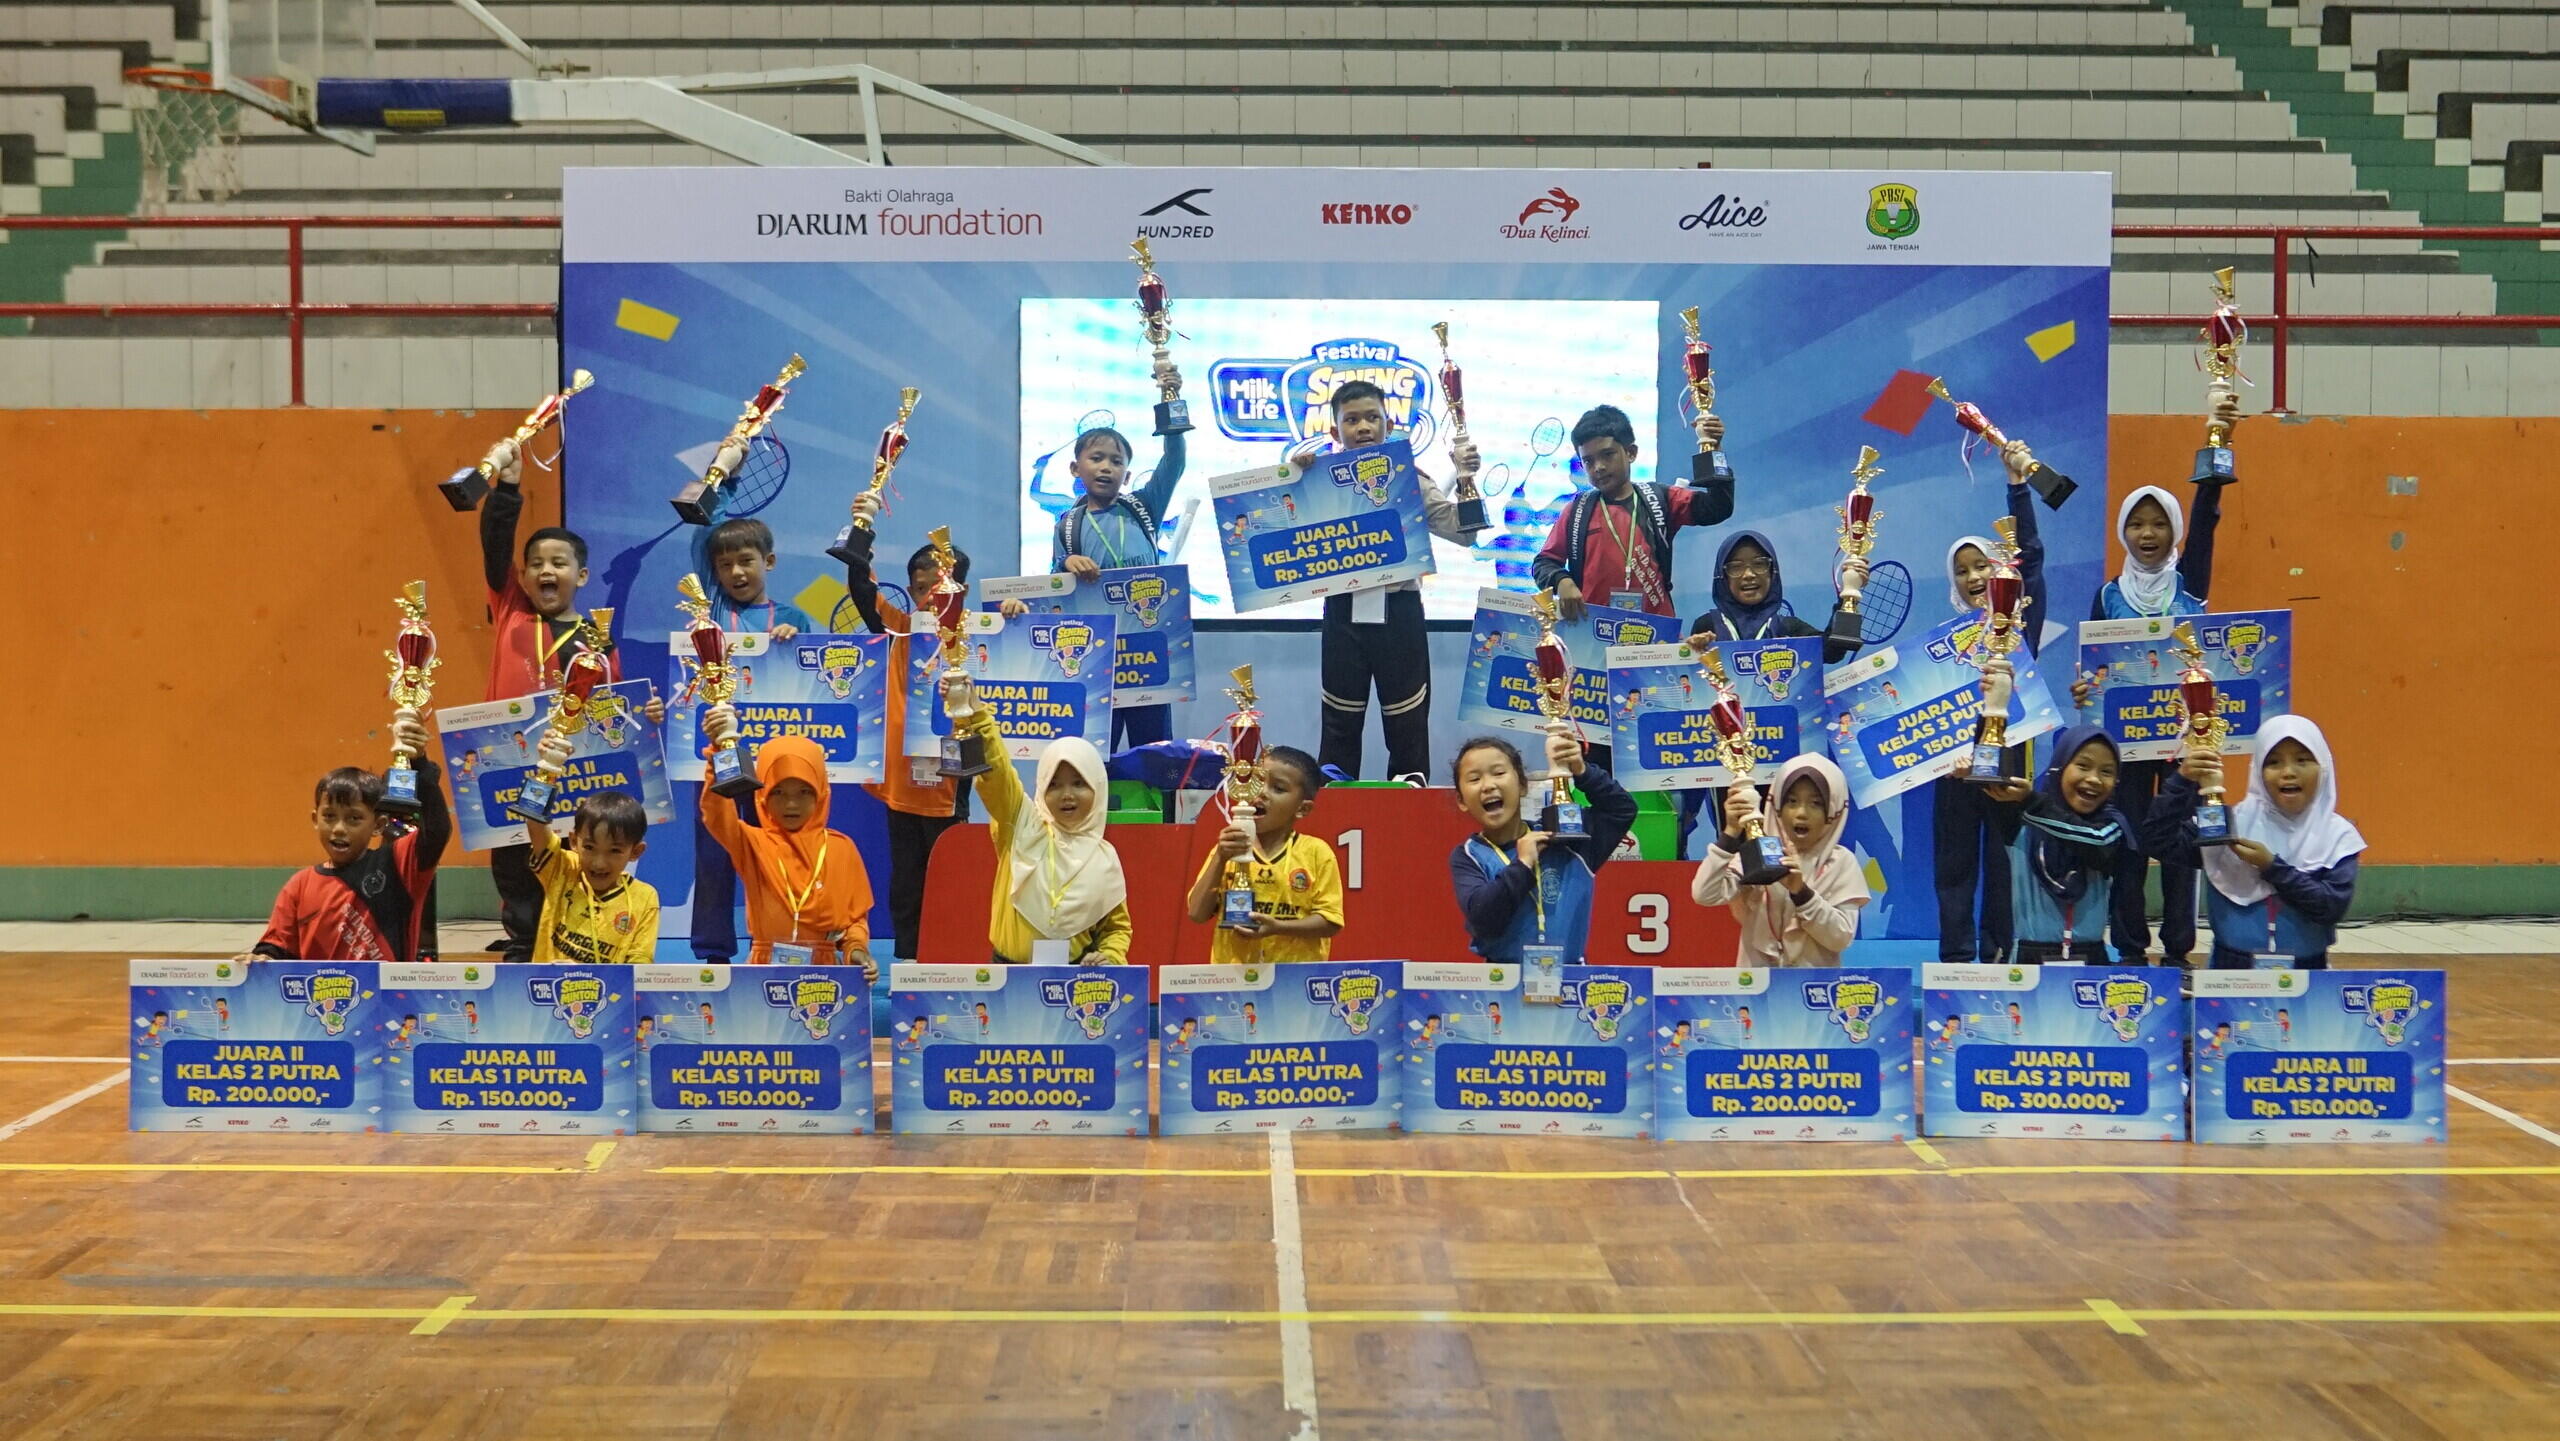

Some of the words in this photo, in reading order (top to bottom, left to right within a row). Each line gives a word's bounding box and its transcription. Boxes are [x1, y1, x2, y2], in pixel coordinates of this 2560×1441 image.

[845, 190, 882, 202] Bakti
[887, 190, 954, 205] Olahraga
[1880, 188, 1905, 202] PBSI
[757, 214, 868, 238] DJARUM
[878, 208, 1042, 236] foundation
[1137, 226, 1214, 238] HUNDRED
[1500, 225, 1536, 239] Dua
[1540, 225, 1588, 243] Kelinci
[1316, 342, 1394, 363] Festival
[1230, 378, 1277, 399] Milk
[1238, 401, 1278, 419] Life
[1357, 457, 1387, 472] SENENG
[1358, 466, 1388, 481] MINTON
[1292, 522, 1349, 545] JUARA
[1353, 521, 1358, 533] I
[1263, 546, 1318, 566] KELAS
[1322, 542, 1332, 554] 3
[1336, 530, 1393, 551] PUTRA
[1275, 568, 1302, 583] Rp.
[1307, 551, 1387, 576] 300.000,-
[1130, 579, 1162, 590] SENENG
[1132, 587, 1162, 599] MINTON
[1056, 627, 1089, 638] SENENG
[1055, 636, 1088, 647] MINTON
[1591, 674, 1606, 688] III
[1032, 687, 1048, 700] III
[1002, 703, 1012, 715] 2
[1016, 704, 1074, 717] PUTRA
[1509, 696, 1534, 711] Rp.
[1897, 699, 1955, 731] JUARA
[1955, 690, 1974, 706] III
[741, 708, 802, 721] JUARA
[807, 708, 812, 721] I
[2120, 705, 2176, 720] KELAS
[770, 724, 781, 737] 2
[785, 724, 846, 738] PUTRA
[1655, 730, 1712, 745] KELAS
[1878, 725, 1935, 755] KELAS
[1938, 718, 1950, 731] 3
[2124, 724, 2151, 739] Rp.
[1661, 751, 1689, 765] Rp.
[1893, 752, 1922, 769] Rp.
[584, 761, 595, 774] II
[568, 773, 628, 793] PUTRA
[1338, 829, 1362, 888] 1
[1626, 893, 1670, 953] 3
[317, 968, 346, 976] Festival
[928, 975, 967, 983] foundation
[1077, 972, 1106, 980] Festival
[313, 977, 353, 989] SENENG
[560, 980, 599, 992] SENENG
[1046, 984, 1063, 993] Milk
[1073, 981, 1113, 993] SENENG
[313, 987, 351, 1000] MINTON
[1048, 991, 1064, 1000] Life
[1072, 991, 1112, 1004] MINTON
[213, 1046, 284, 1062] JUARA
[290, 1046, 304, 1060] II
[460, 1050, 530, 1066] JUARA
[536, 1050, 556, 1066] III
[697, 1050, 768, 1066] JUARA
[774, 1052, 792, 1066] III
[974, 1050, 1046, 1066] JUARA
[1052, 1050, 1064, 1064] II
[1245, 1048, 1314, 1064] JUARA
[1320, 1048, 1326, 1060] I
[1489, 1050, 1560, 1066] JUARA
[1566, 1052, 1572, 1066] I
[1738, 1054, 1808, 1070] JUARA
[1816, 1054, 1828, 1068] II
[2010, 1052, 2080, 1066] JUARA
[2088, 1054, 2094, 1066] I
[176, 1064, 246, 1080] KELAS
[252, 1064, 264, 1080] 2
[268, 1064, 340, 1080] PUTRA
[1208, 1068, 1276, 1084] KELAS
[1280, 1066, 1288, 1080] 1
[1294, 1064, 1362, 1080] PUTRA
[2272, 1058, 2342, 1074] JUARA
[2348, 1058, 2366, 1072] III
[430, 1068, 498, 1084] KELAS
[504, 1068, 510, 1082] 1
[516, 1068, 586, 1084] PUTRA
[672, 1068, 740, 1084] KELAS
[744, 1068, 754, 1084] 1
[758, 1068, 820, 1084] PUTRI
[944, 1068, 1014, 1084] KELAS
[1018, 1068, 1026, 1082] 1
[1032, 1068, 1094, 1084] PUTRI
[1456, 1068, 1524, 1084] KELAS
[1530, 1070, 1538, 1084] 1
[1544, 1070, 1606, 1086] PUTRI
[1706, 1074, 1774, 1090] KELAS
[1782, 1074, 1792, 1088] 2
[1798, 1072, 1862, 1088] PUTRI
[1974, 1070, 2044, 1086] KELAS
[2050, 1070, 2062, 1086] 2
[2068, 1070, 2130, 1086] PUTRI
[2244, 1076, 2310, 1092] KELAS
[2316, 1078, 2328, 1092] 2
[2334, 1076, 2394, 1092] PUTRI
[188, 1086, 220, 1104] Rp.
[226, 1086, 330, 1104] 200.000,-
[442, 1090, 472, 1108] Rp.
[480, 1090, 576, 1108] 150.000,-
[680, 1090, 712, 1108] Rp.
[718, 1090, 814, 1108] 150.000,-
[948, 1090, 980, 1108] Rp.
[988, 1090, 1090, 1106] 200.000,-
[1216, 1090, 1248, 1108] Rp.
[1256, 1086, 1355, 1104] 300.000,-
[1460, 1090, 1492, 1108] Rp.
[1500, 1090, 1602, 1108] 300.000,-
[1982, 1092, 2012, 1110] Rp.
[2022, 1092, 2124, 1110] 300.000,-
[1712, 1096, 1744, 1114] Rp.
[1752, 1096, 1855, 1112] 200.000,-
[2252, 1100, 2284, 1116] Rp.
[2292, 1100, 2386, 1116] 150.000,-
